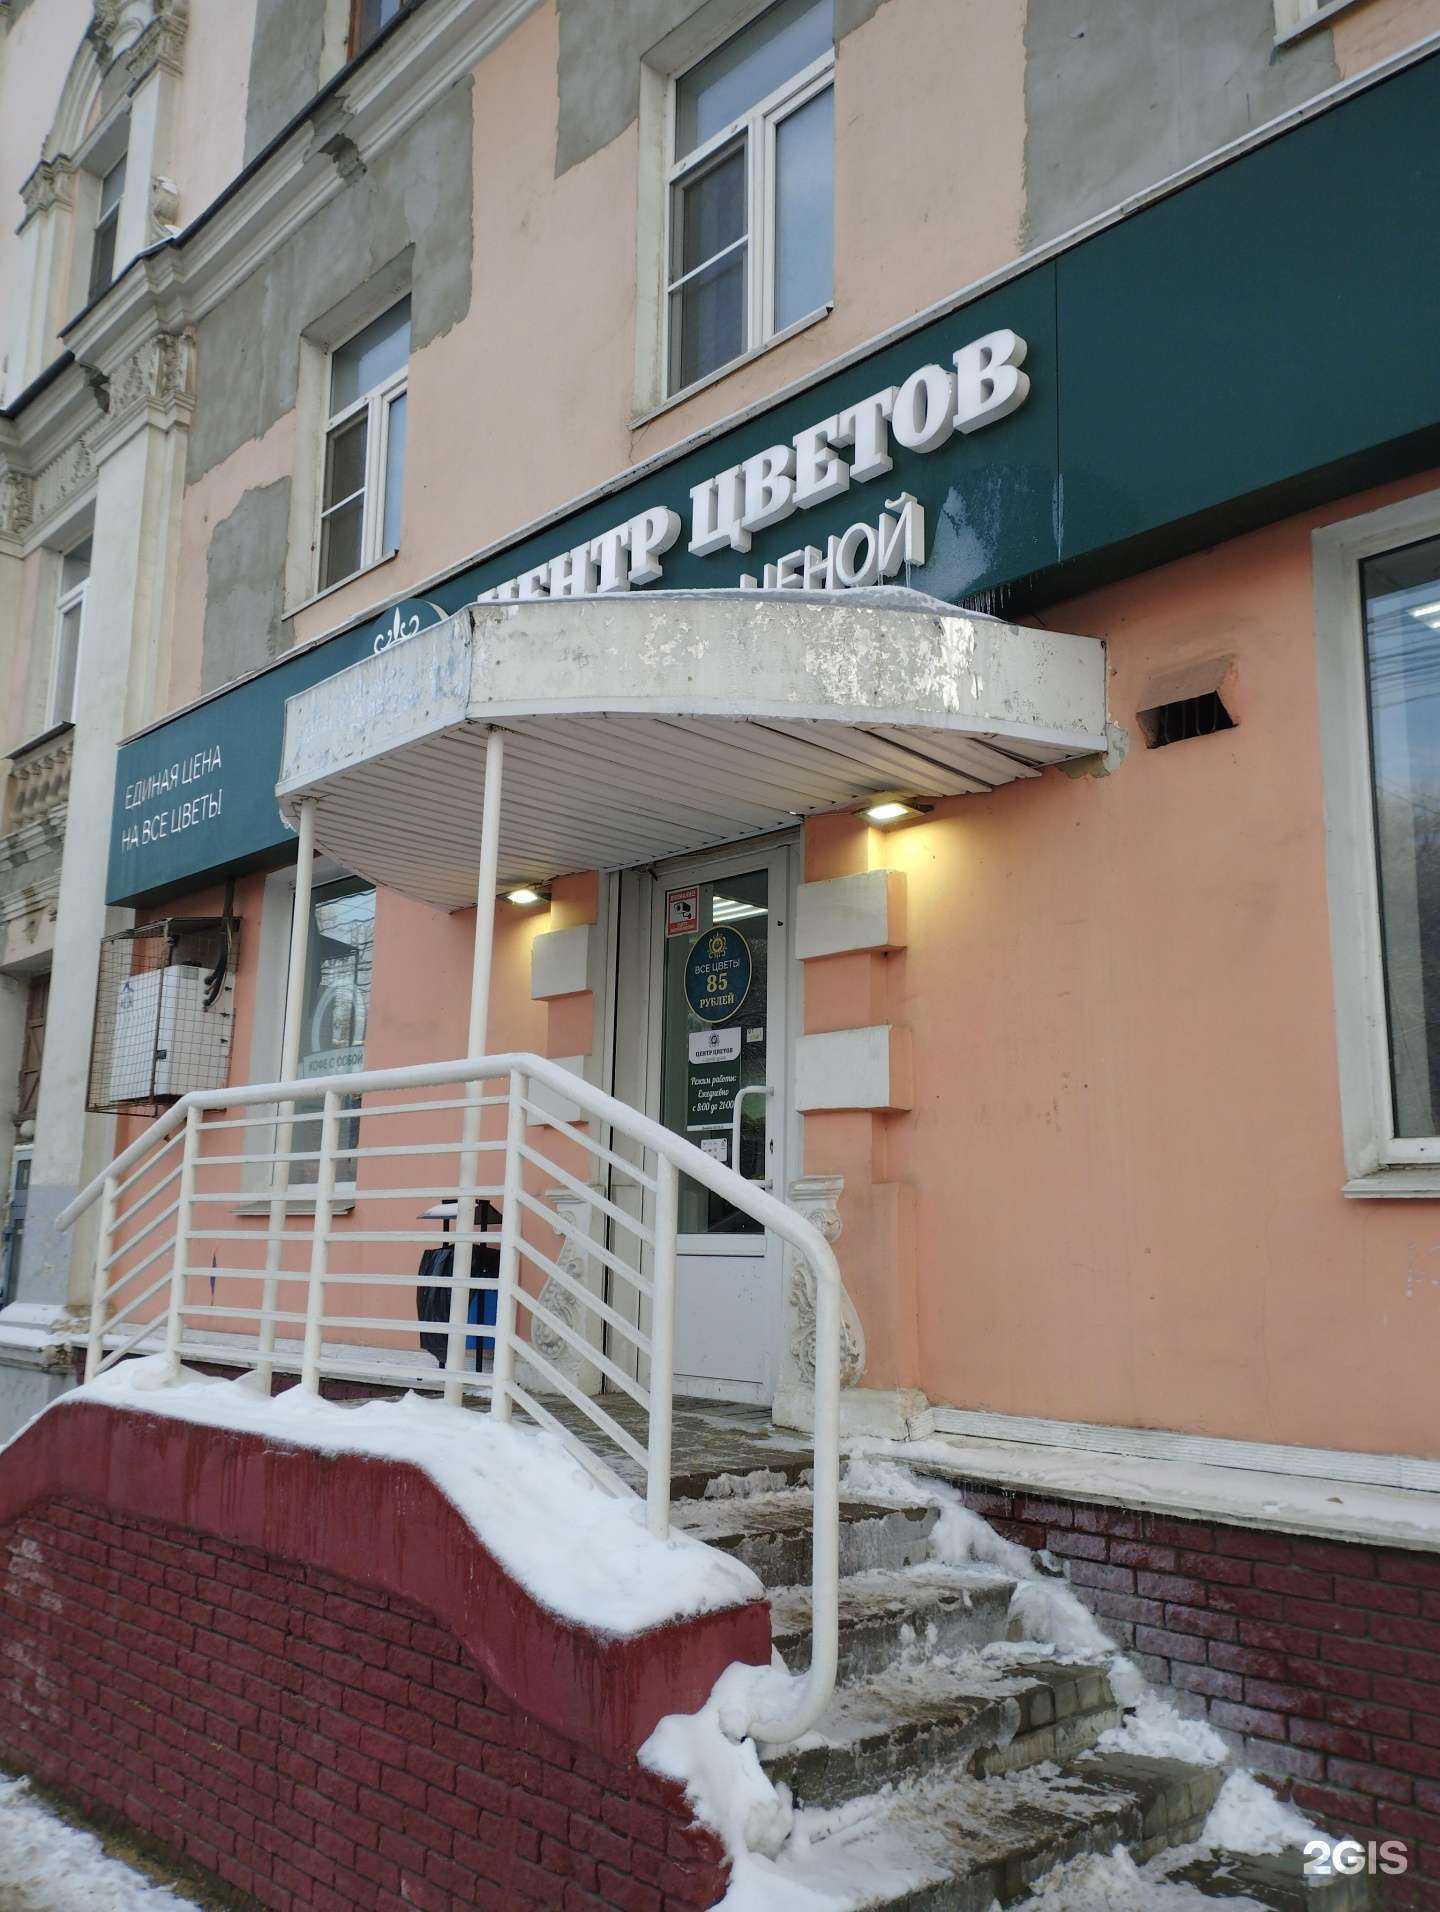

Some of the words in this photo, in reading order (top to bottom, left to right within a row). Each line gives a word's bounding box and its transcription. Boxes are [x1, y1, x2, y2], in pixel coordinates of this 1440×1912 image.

[477, 505, 682, 601] ЕНТР
[688, 328, 1031, 554] ЦВЕТОВ
[740, 491, 925, 590] ЕНОЙ
[125, 763, 179, 810] ЕДИНАЯ
[181, 744, 222, 785] ЦЕНА
[121, 824, 139, 856] НА
[142, 811, 169, 845] ВСЕ
[170, 788, 223, 834] ЦВЕТЫ
[694, 962, 711, 975] ВСЕ
[712, 959, 740, 974] ЦВЕТЫ
[706, 973, 728, 993] 85
[699, 992, 736, 1009] РУБЛЕЙ
